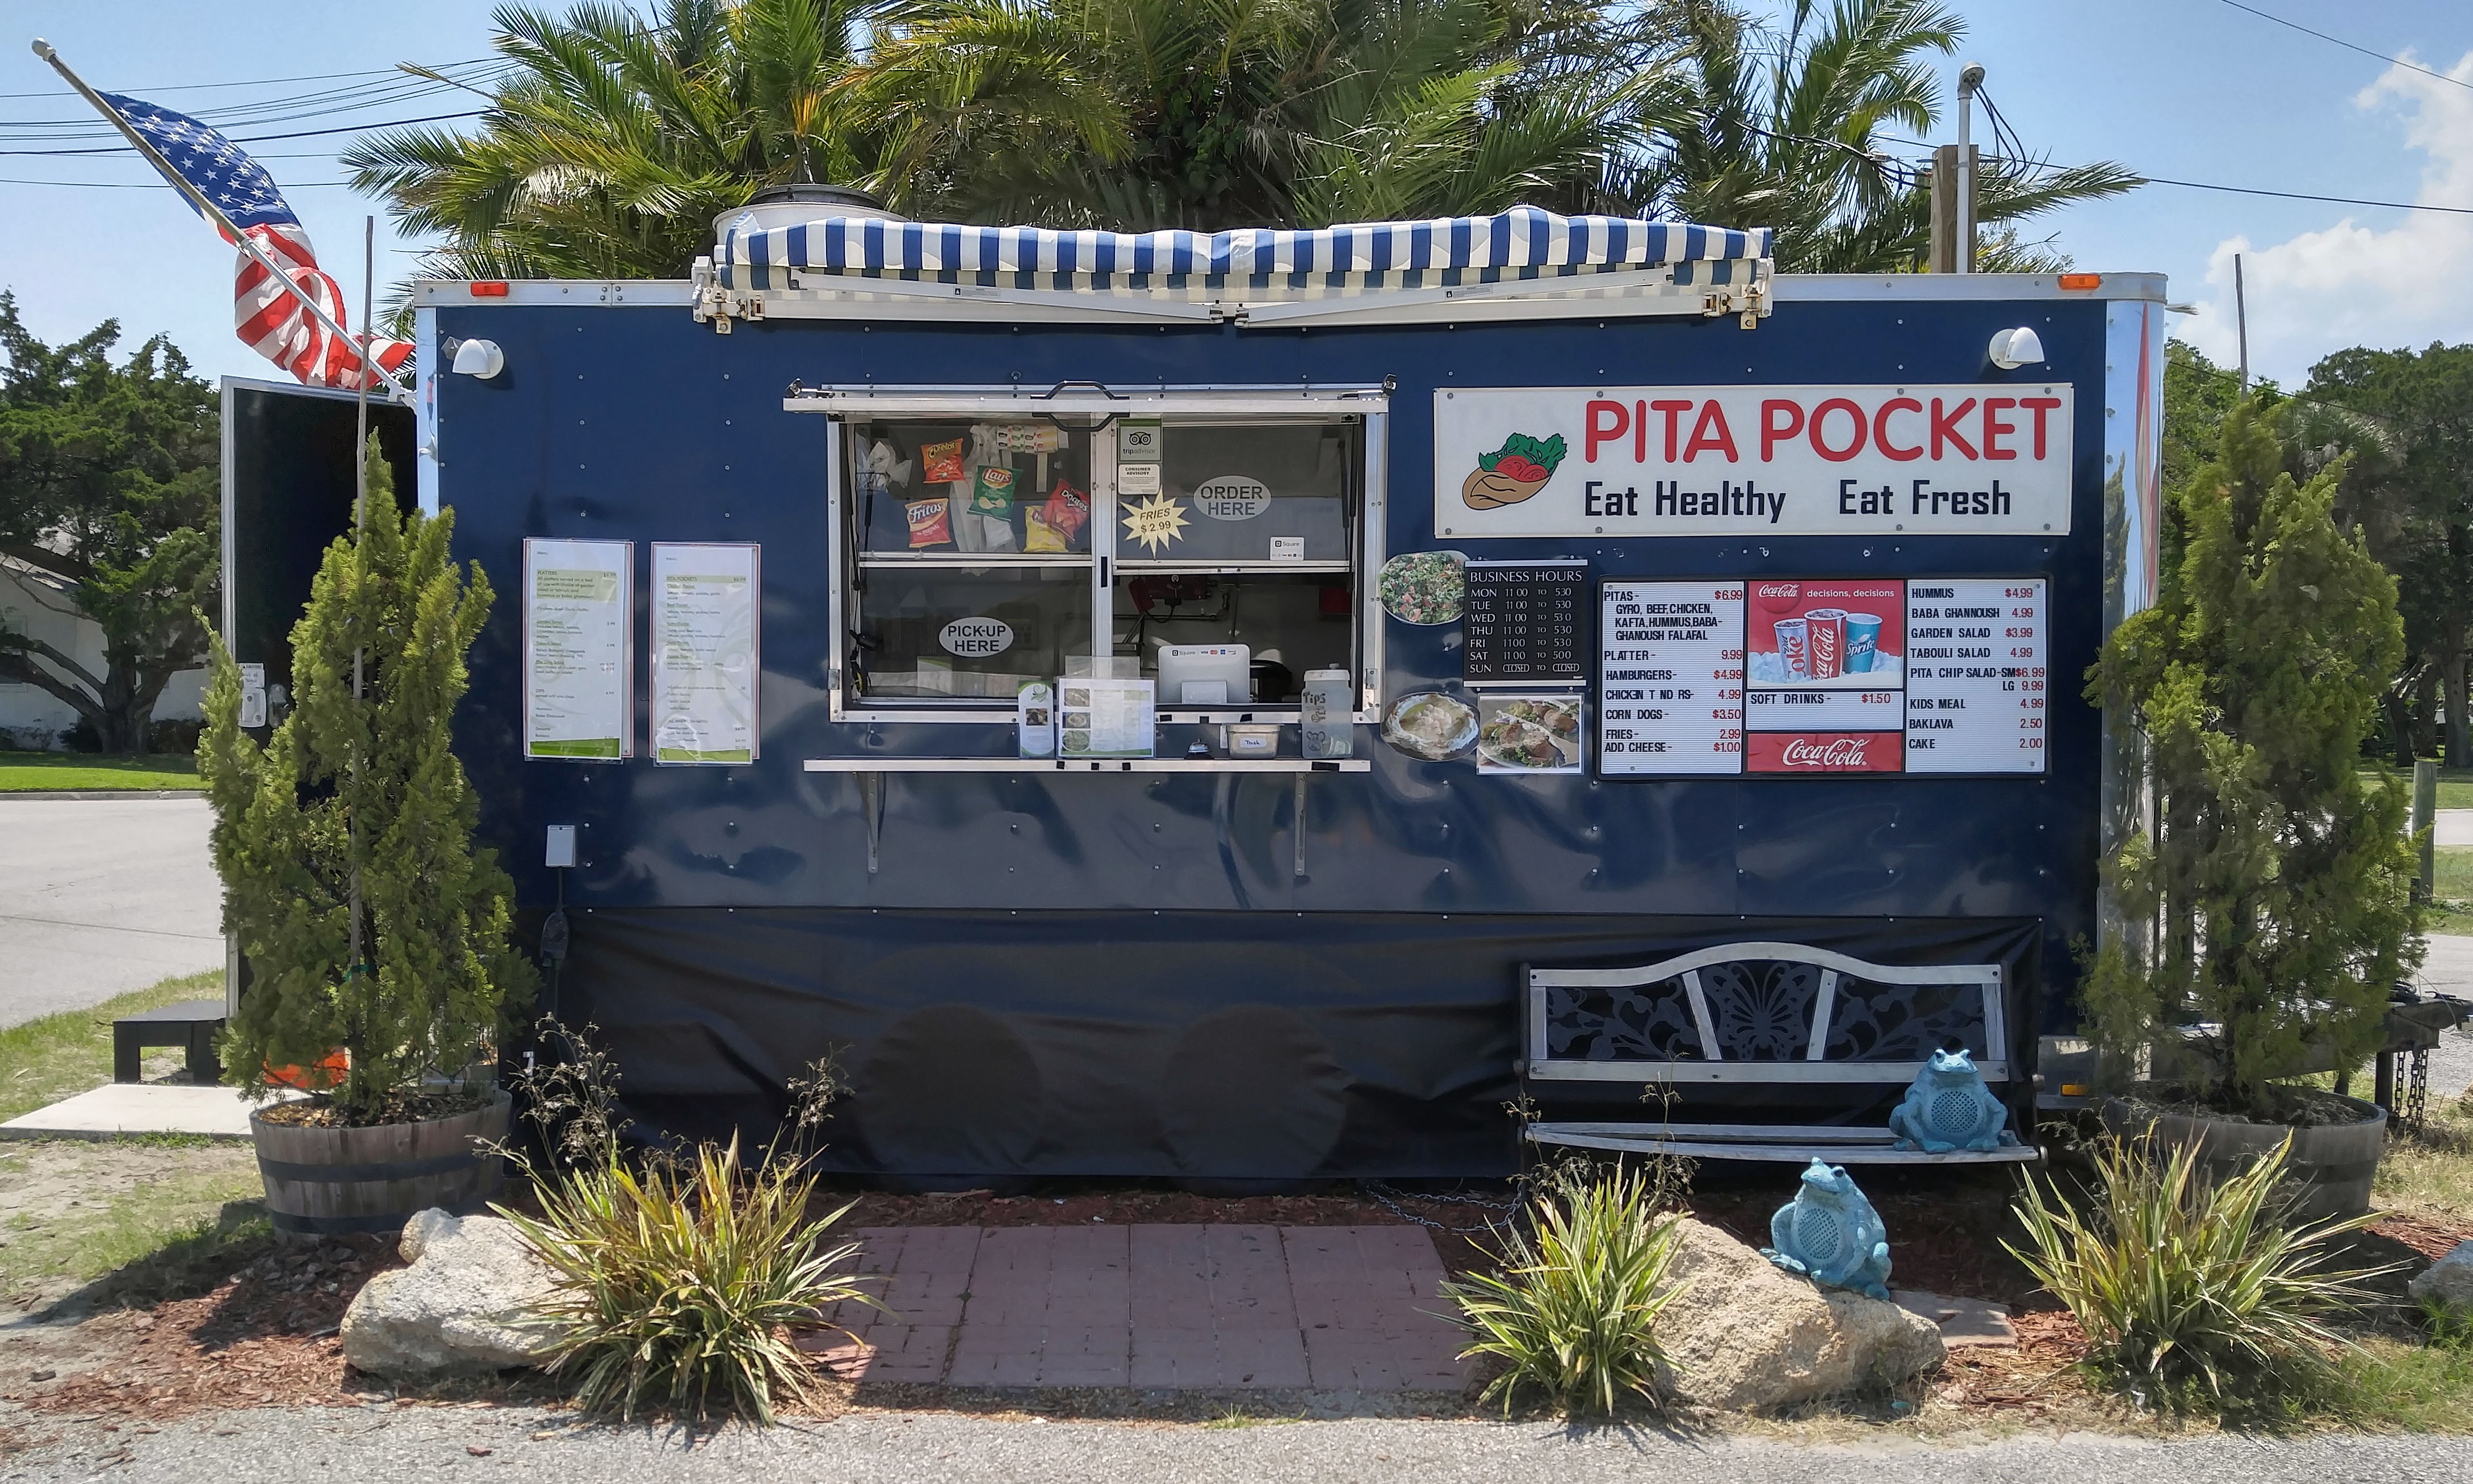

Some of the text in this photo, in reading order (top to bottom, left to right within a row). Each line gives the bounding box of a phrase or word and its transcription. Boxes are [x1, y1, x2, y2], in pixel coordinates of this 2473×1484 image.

[1585, 397, 2061, 463] PITA POCKET
[928, 441, 957, 459] Cheetos
[1201, 486, 1263, 500] ORDER
[1061, 489, 1088, 512] Doritos
[1585, 480, 2010, 523] Eat Healthy Eat Fresh
[909, 503, 941, 523] Fritos
[1208, 502, 1255, 515] HERE
[1140, 508, 1170, 521] FRIES
[1470, 571, 1582, 582] BUSINESS HOURS
[1471, 589, 1497, 597] MON
[1715, 590, 1743, 600] $6.99
[1758, 584, 1800, 598] Coca-Cola
[1806, 589, 1894, 598] decisions, decisions
[1912, 588, 2032, 598] HUMMUS $4.99
[1470, 601, 1490, 610] TUE
[1616, 603, 1642, 615] GYRO,
[1471, 614, 1495, 622] WED
[1912, 607, 2033, 618] BABA GHANNOUSH 4.99
[948, 626, 1006, 637] PICK-UP
[1470, 626, 1493, 635] THU
[1616, 630, 1708, 640] GHANOUSH FALAFAL
[1911, 627, 2032, 638] GARDEN SALAD $3.99
[954, 640, 1000, 652] HERE
[1470, 639, 1485, 648] FRI
[1846, 638, 1875, 656] Sprite
[1470, 651, 1489, 660] SAT
[1721, 649, 1742, 660] 9.99
[1910, 647, 2032, 658] TABOULI SALAD 4.99
[1470, 664, 1491, 673] SUN
[1911, 668, 1932, 678] PITA
[1939, 668, 1964, 678] CHIP
[2015, 667, 2045, 678] $6.99
[1606, 669, 1742, 681] HAMBURGERS- $4.99
[2003, 681, 2043, 691] LG 9.99
[1303, 691, 1326, 705] Tips
[1718, 689, 1741, 699] 4.99
[1751, 694, 1777, 704] SOFT
[1862, 693, 1891, 703] $1.50
[1910, 698, 2043, 709] KIDS MEAL 4.99
[1606, 710, 1631, 719] CORN
[1712, 709, 1741, 719] $3.50
[1909, 718, 2042, 729] BAKLAVA 2.50
[1720, 728, 1741, 739] 2.99
[1604, 742, 1624, 752] ADD
[1713, 742, 1741, 752] $1.00
[1909, 738, 2042, 749] CAKE 2.00
[1782, 739, 1871, 766] Coca-Cola
